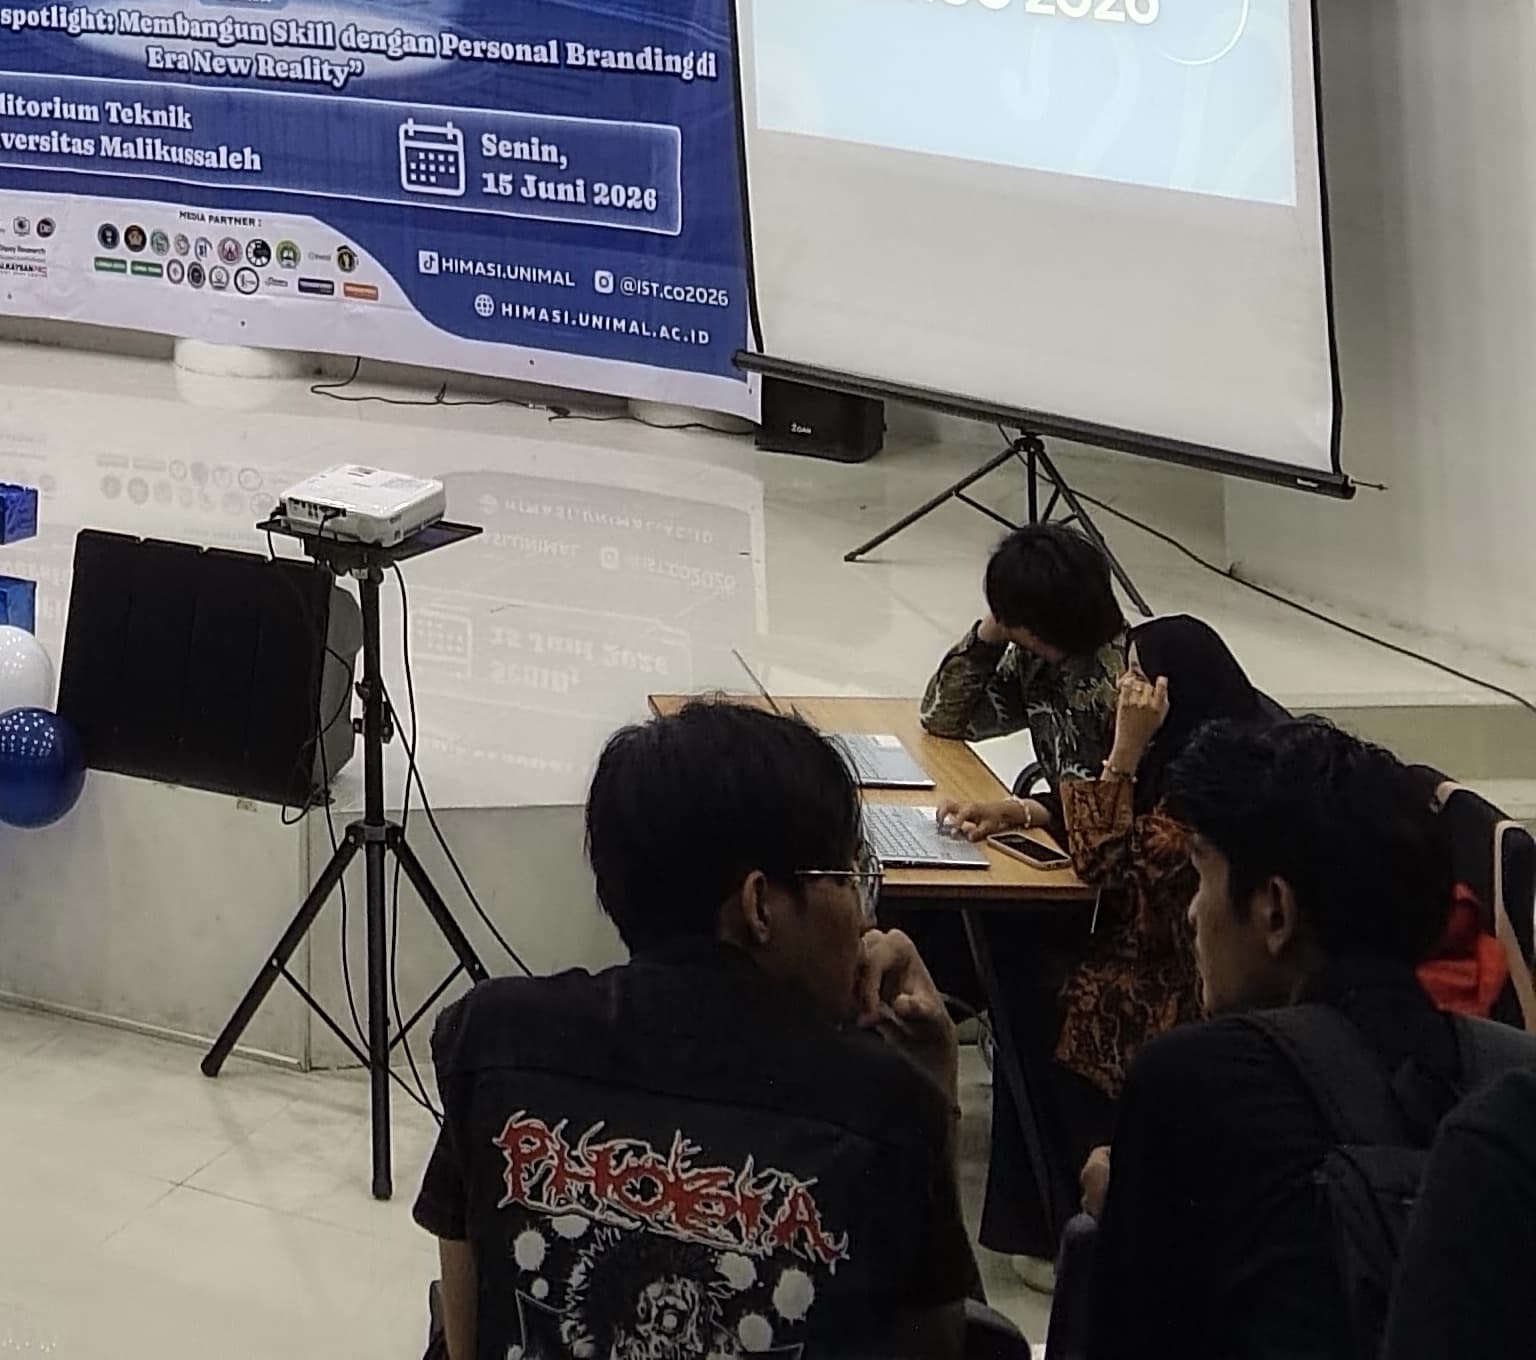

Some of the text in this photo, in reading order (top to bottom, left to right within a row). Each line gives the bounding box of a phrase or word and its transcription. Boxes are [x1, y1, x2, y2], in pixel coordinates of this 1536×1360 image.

[0, 5, 115, 35] spotlight:
[119, 11, 266, 45] Membangun
[271, 20, 337, 48] Skill
[341, 25, 435, 58] dengan
[440, 33, 560, 65] Personal
[147, 46, 190, 72] Era
[193, 50, 252, 76] New
[105, 100, 193, 130] Teknik
[100, 136, 263, 172] Malikussaleh
[480, 132, 568, 169] Senin,
[481, 172, 659, 212] 15 Juni 2026
[179, 210, 206, 223] MEDIA
[208, 214, 256, 228] PARTNER
[441, 258, 576, 288] HIMASI.UNIMAL
[620, 276, 729, 308] @IST.CO2026
[501, 301, 711, 345] HIMASI.UNIMAL.AC.ID
